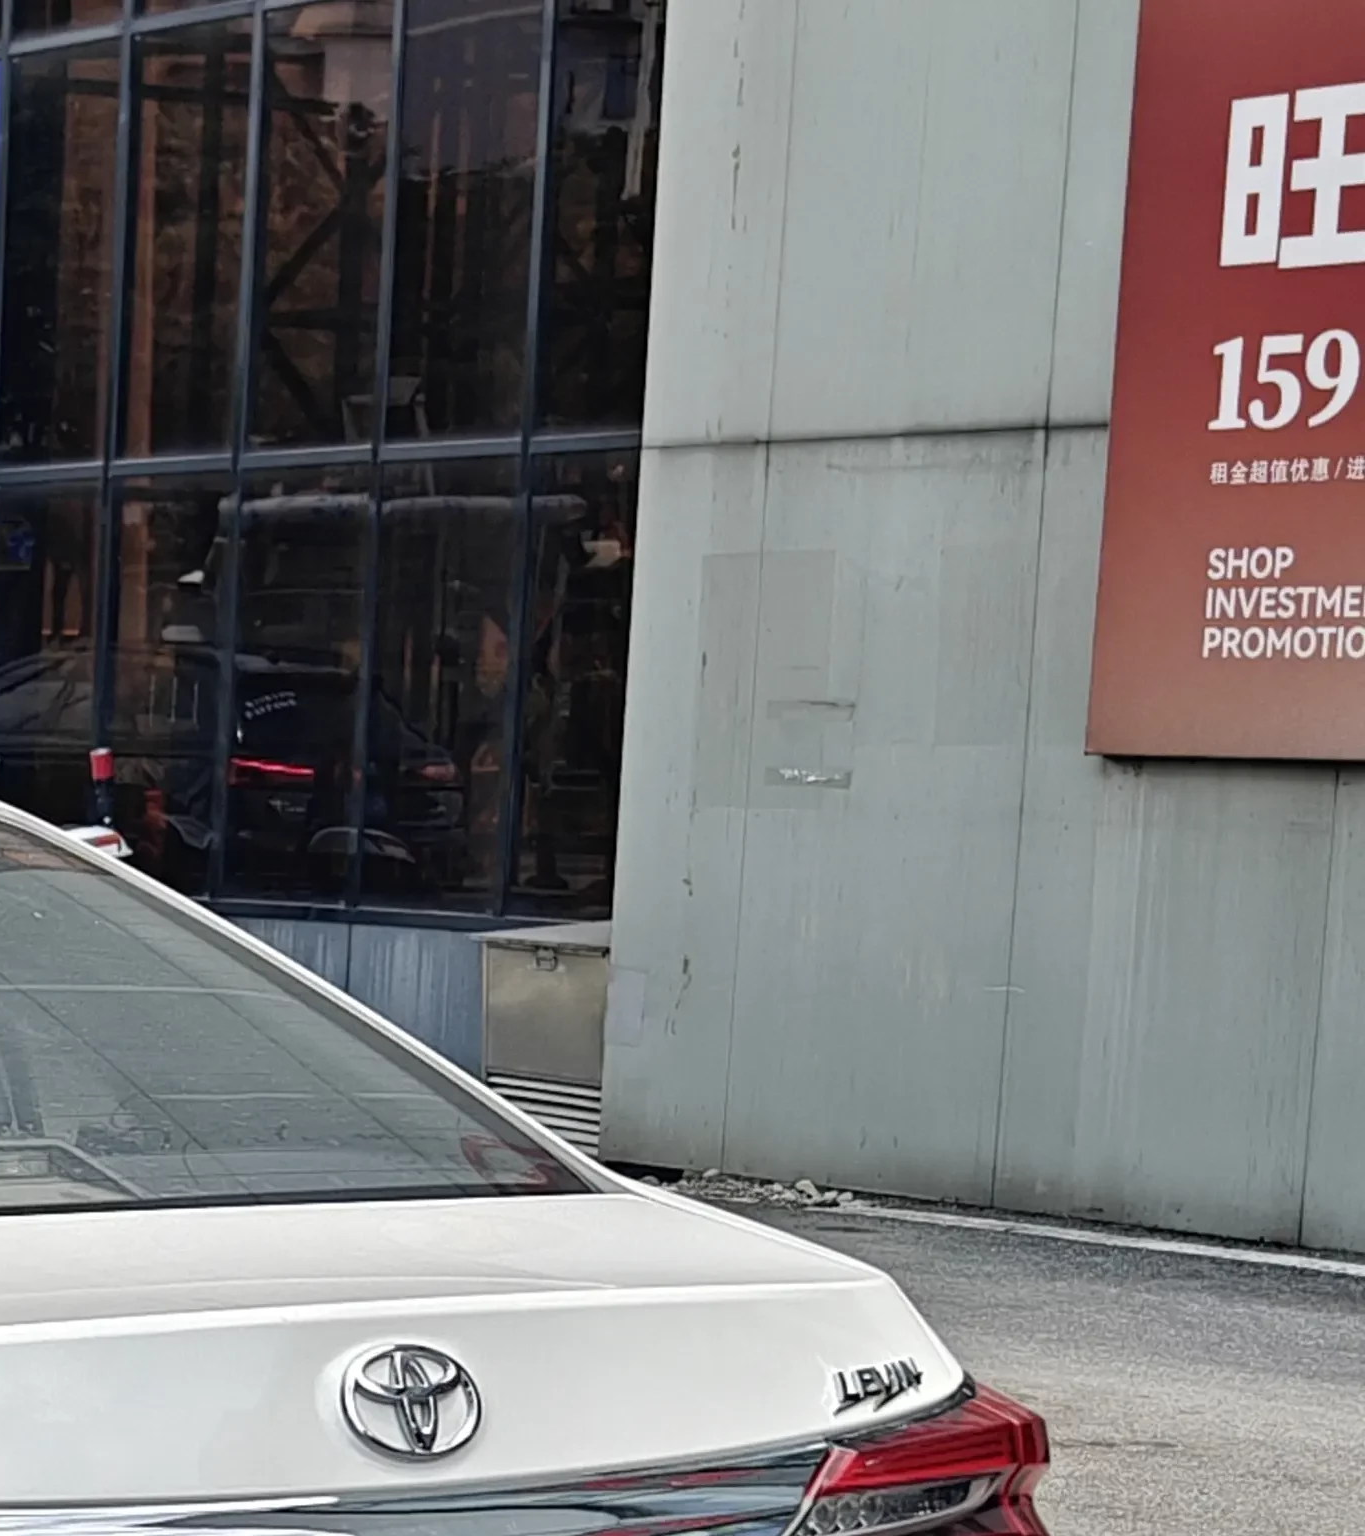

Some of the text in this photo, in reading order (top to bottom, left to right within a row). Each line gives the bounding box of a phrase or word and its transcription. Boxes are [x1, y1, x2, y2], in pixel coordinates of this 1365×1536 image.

[1207, 329, 1362, 431] 159
[1207, 546, 1294, 580] SHOP
[1205, 585, 1365, 619] INVESTME
[831, 1357, 924, 1416] LEVIN
